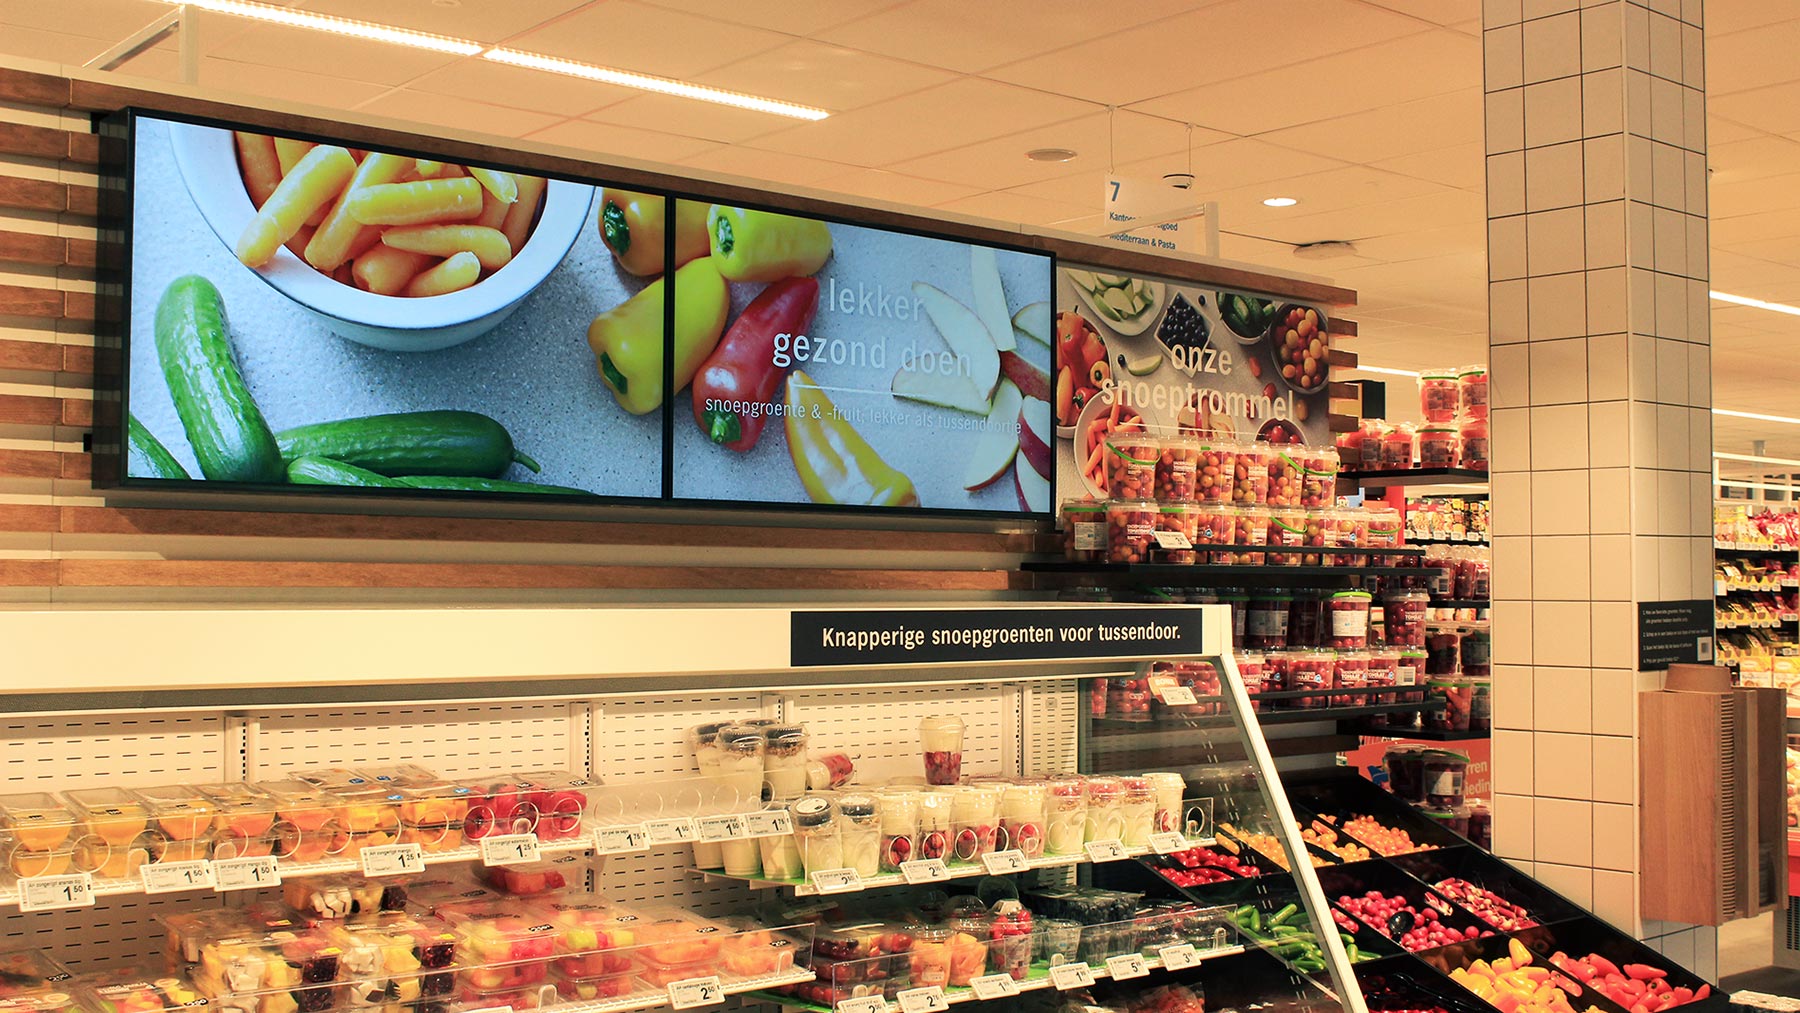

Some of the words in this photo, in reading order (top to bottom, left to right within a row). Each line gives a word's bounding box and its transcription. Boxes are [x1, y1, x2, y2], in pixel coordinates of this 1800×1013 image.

[1110, 181, 1120, 202] 7
[1151, 239, 1157, 247] &
[1158, 240, 1176, 250] Pasta
[829, 278, 925, 322] lekker
[772, 332, 887, 368] gezond
[902, 340, 971, 377] doen
[1172, 344, 1232, 375] onze
[1101, 378, 1293, 420] snoeptrommel
[705, 398, 806, 418] snoepgroente
[811, 404, 822, 419] &
[870, 407, 910, 426] lekker
[916, 412, 933, 428] als
[938, 415, 1022, 435] tussendoortje
[823, 625, 925, 651] Knapperige
[931, 625, 1054, 649] snoepgroenten
[1059, 626, 1094, 642] voor
[1098, 622, 1181, 641] tussendoor.
